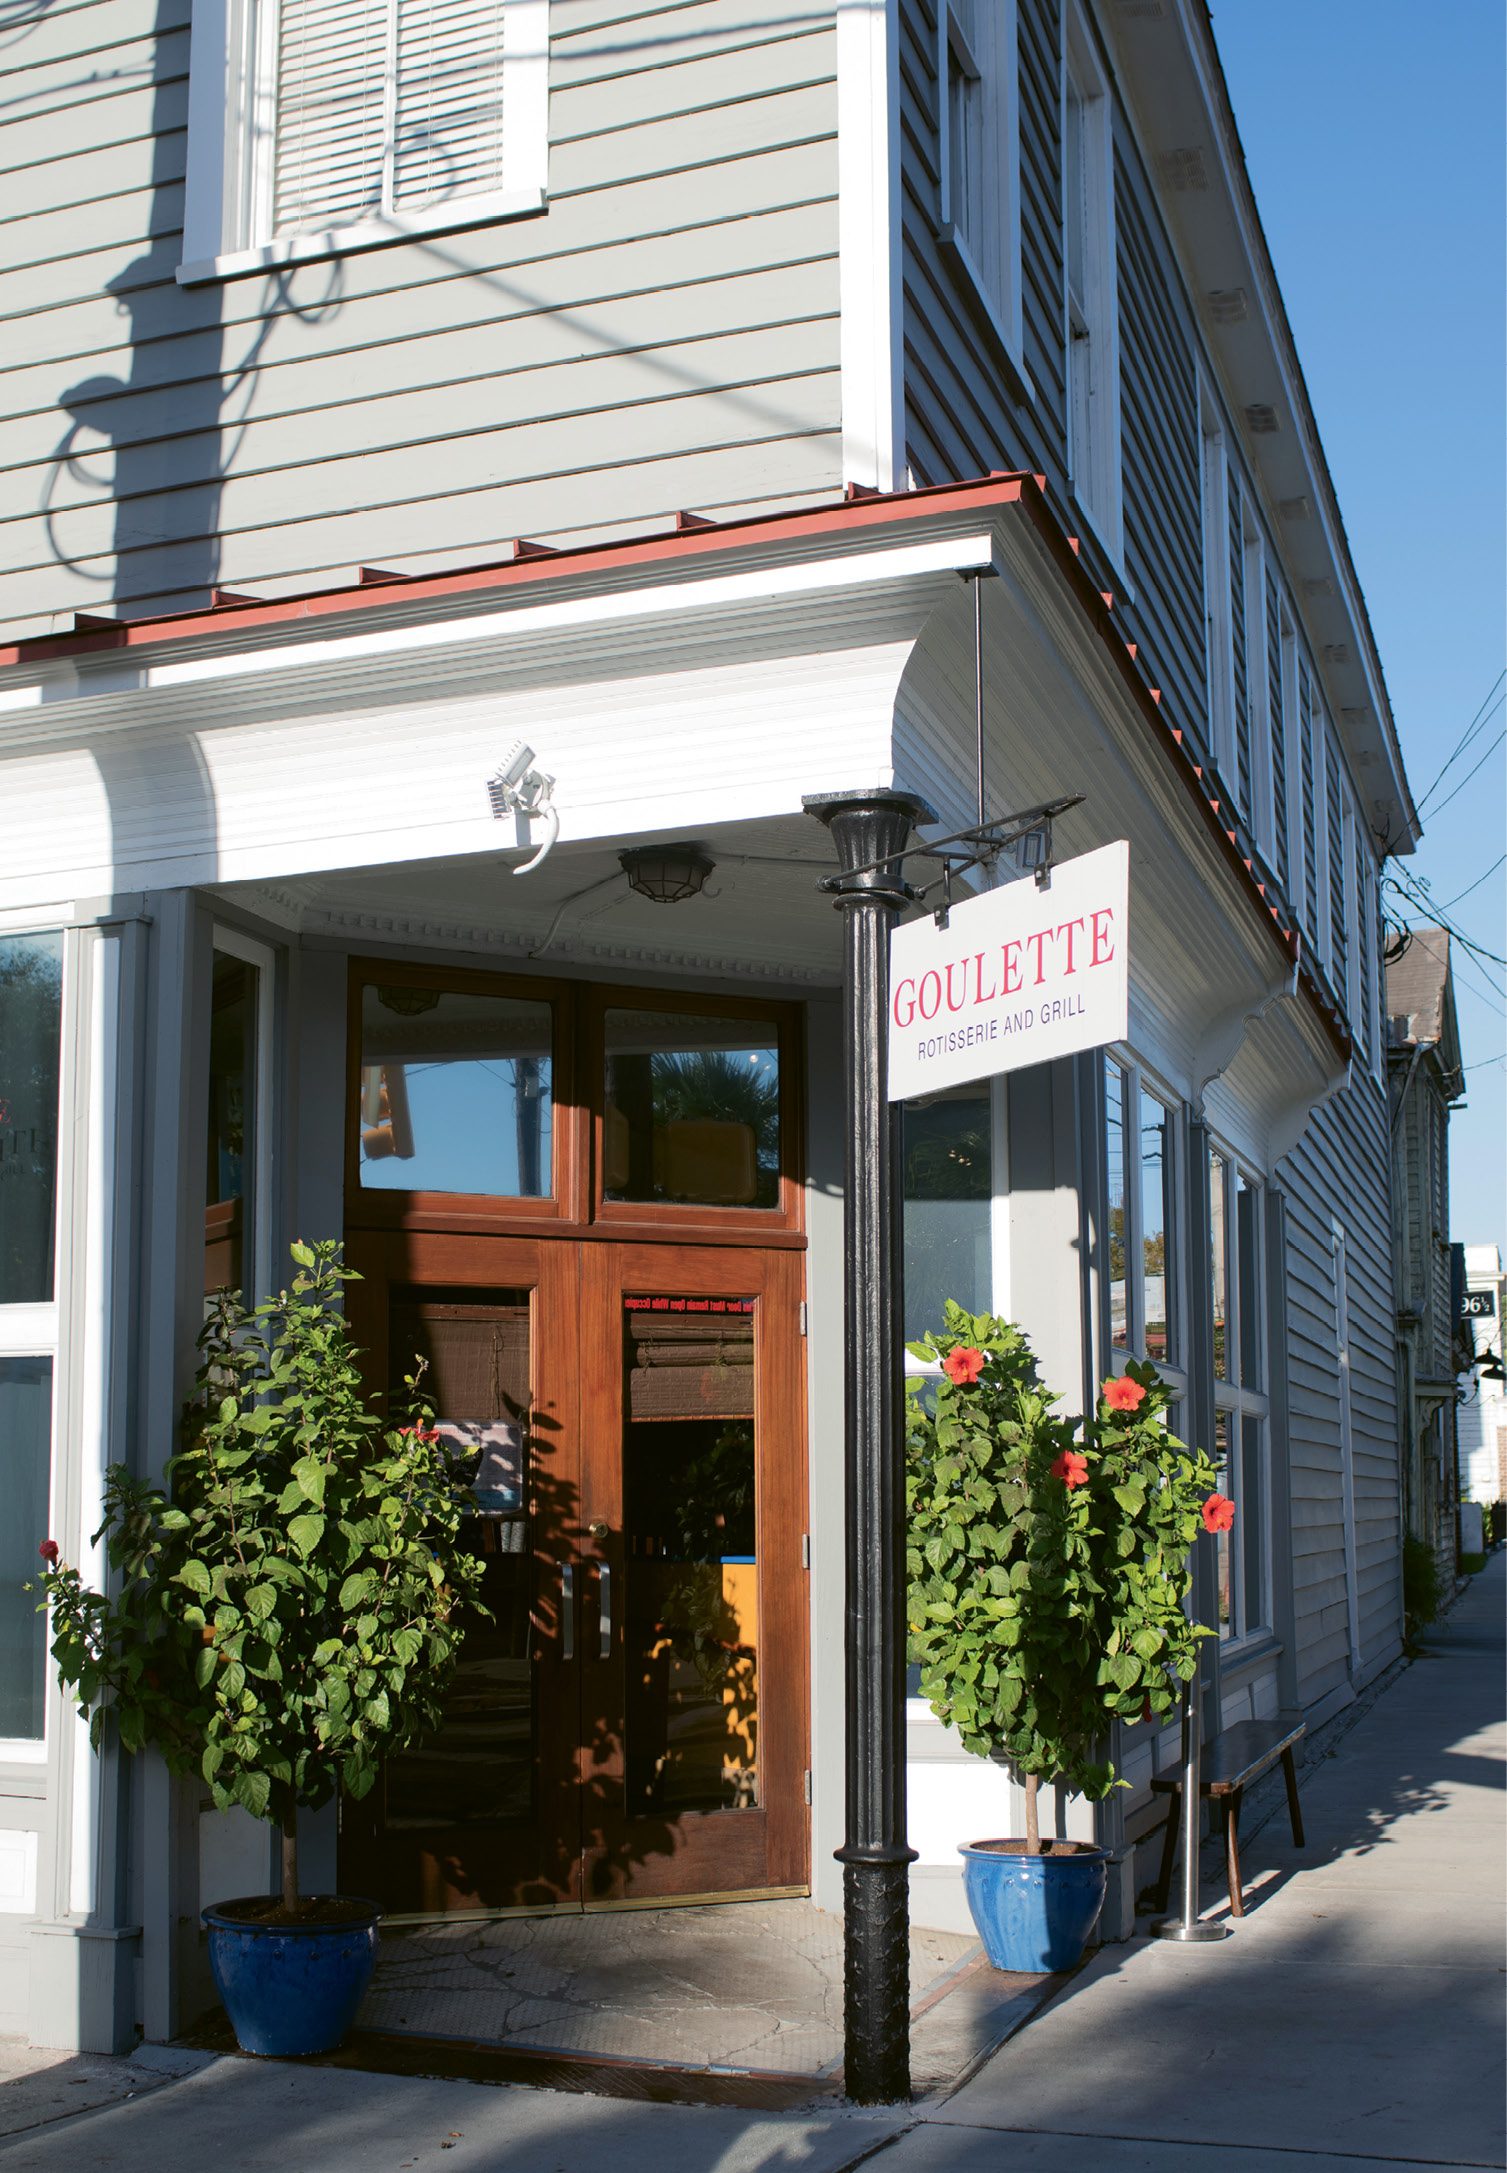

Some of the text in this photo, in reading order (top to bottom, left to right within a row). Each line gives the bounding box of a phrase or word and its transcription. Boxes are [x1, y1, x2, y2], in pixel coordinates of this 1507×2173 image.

[893, 907, 1115, 1028] GOULETTE
[918, 994, 1086, 1061] ROTISSERIE AND GRILL
